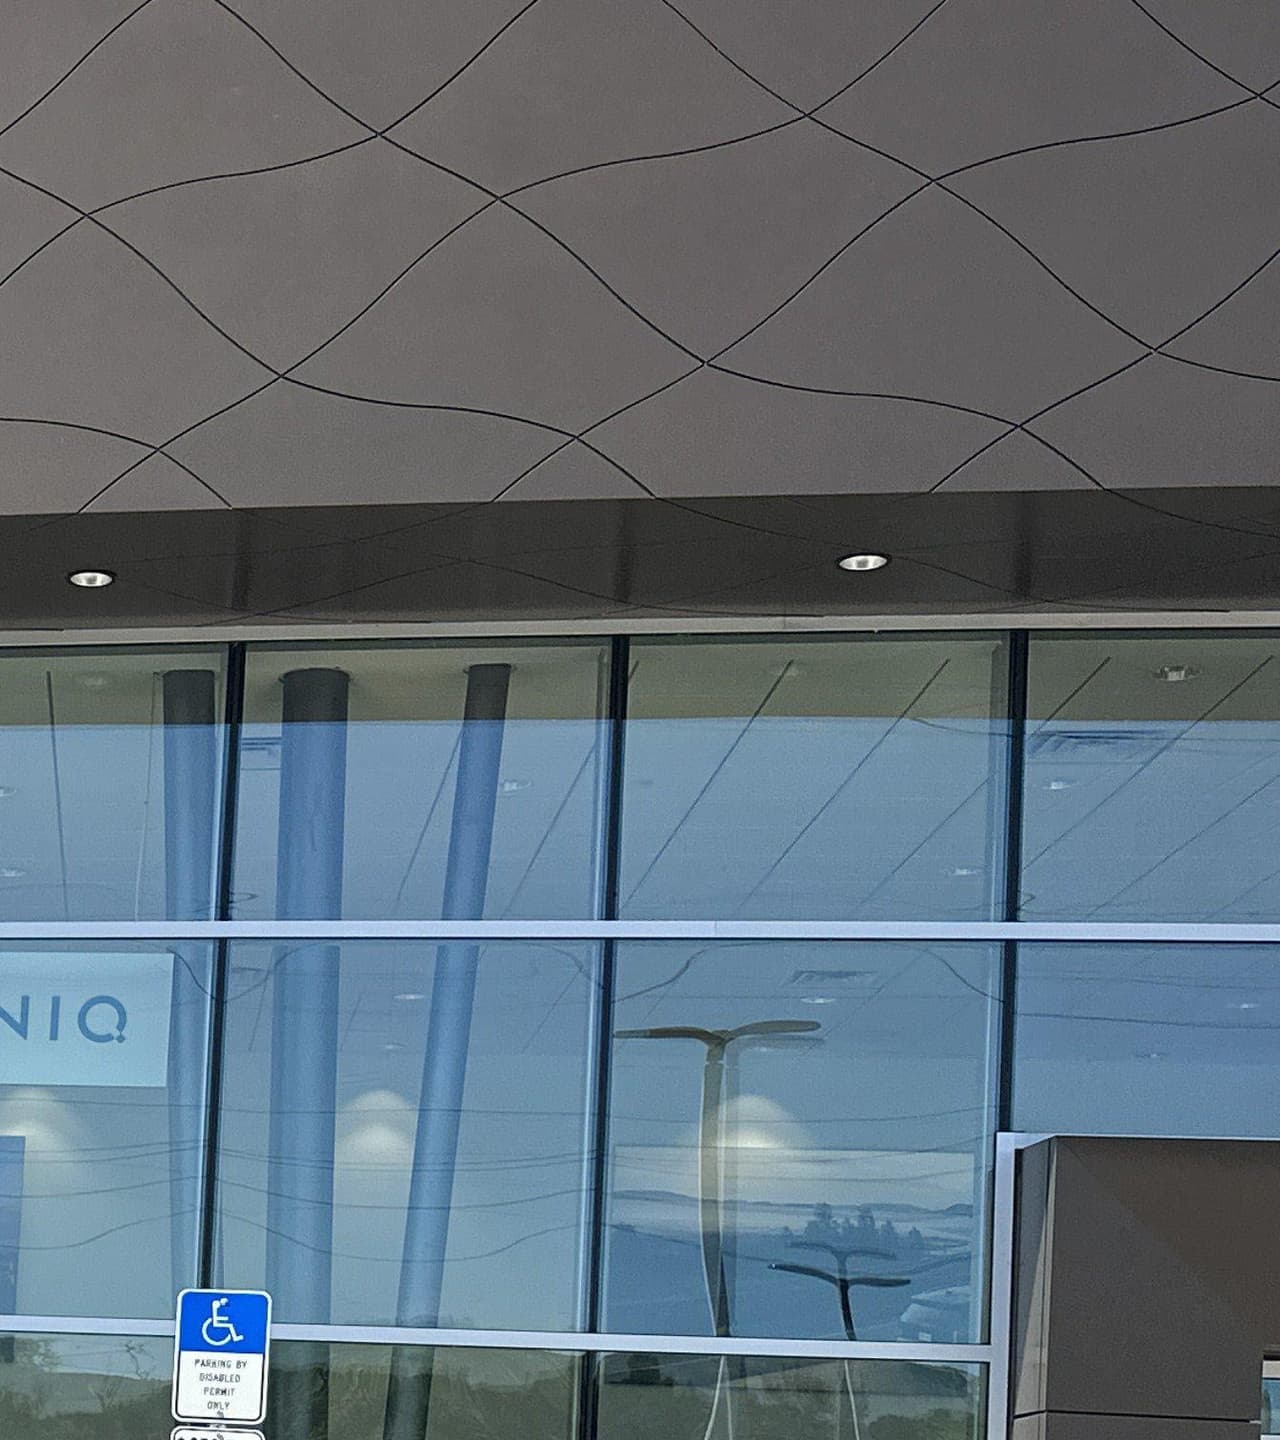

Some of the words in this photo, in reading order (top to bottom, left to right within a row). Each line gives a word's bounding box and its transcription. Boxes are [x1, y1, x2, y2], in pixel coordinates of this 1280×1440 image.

[194, 1359, 232, 1369] PARKING
[235, 1360, 248, 1369] BY
[199, 1373, 241, 1383] DISABLED
[203, 1387, 236, 1397] PERMIT
[207, 1401, 231, 1411] ONLY
